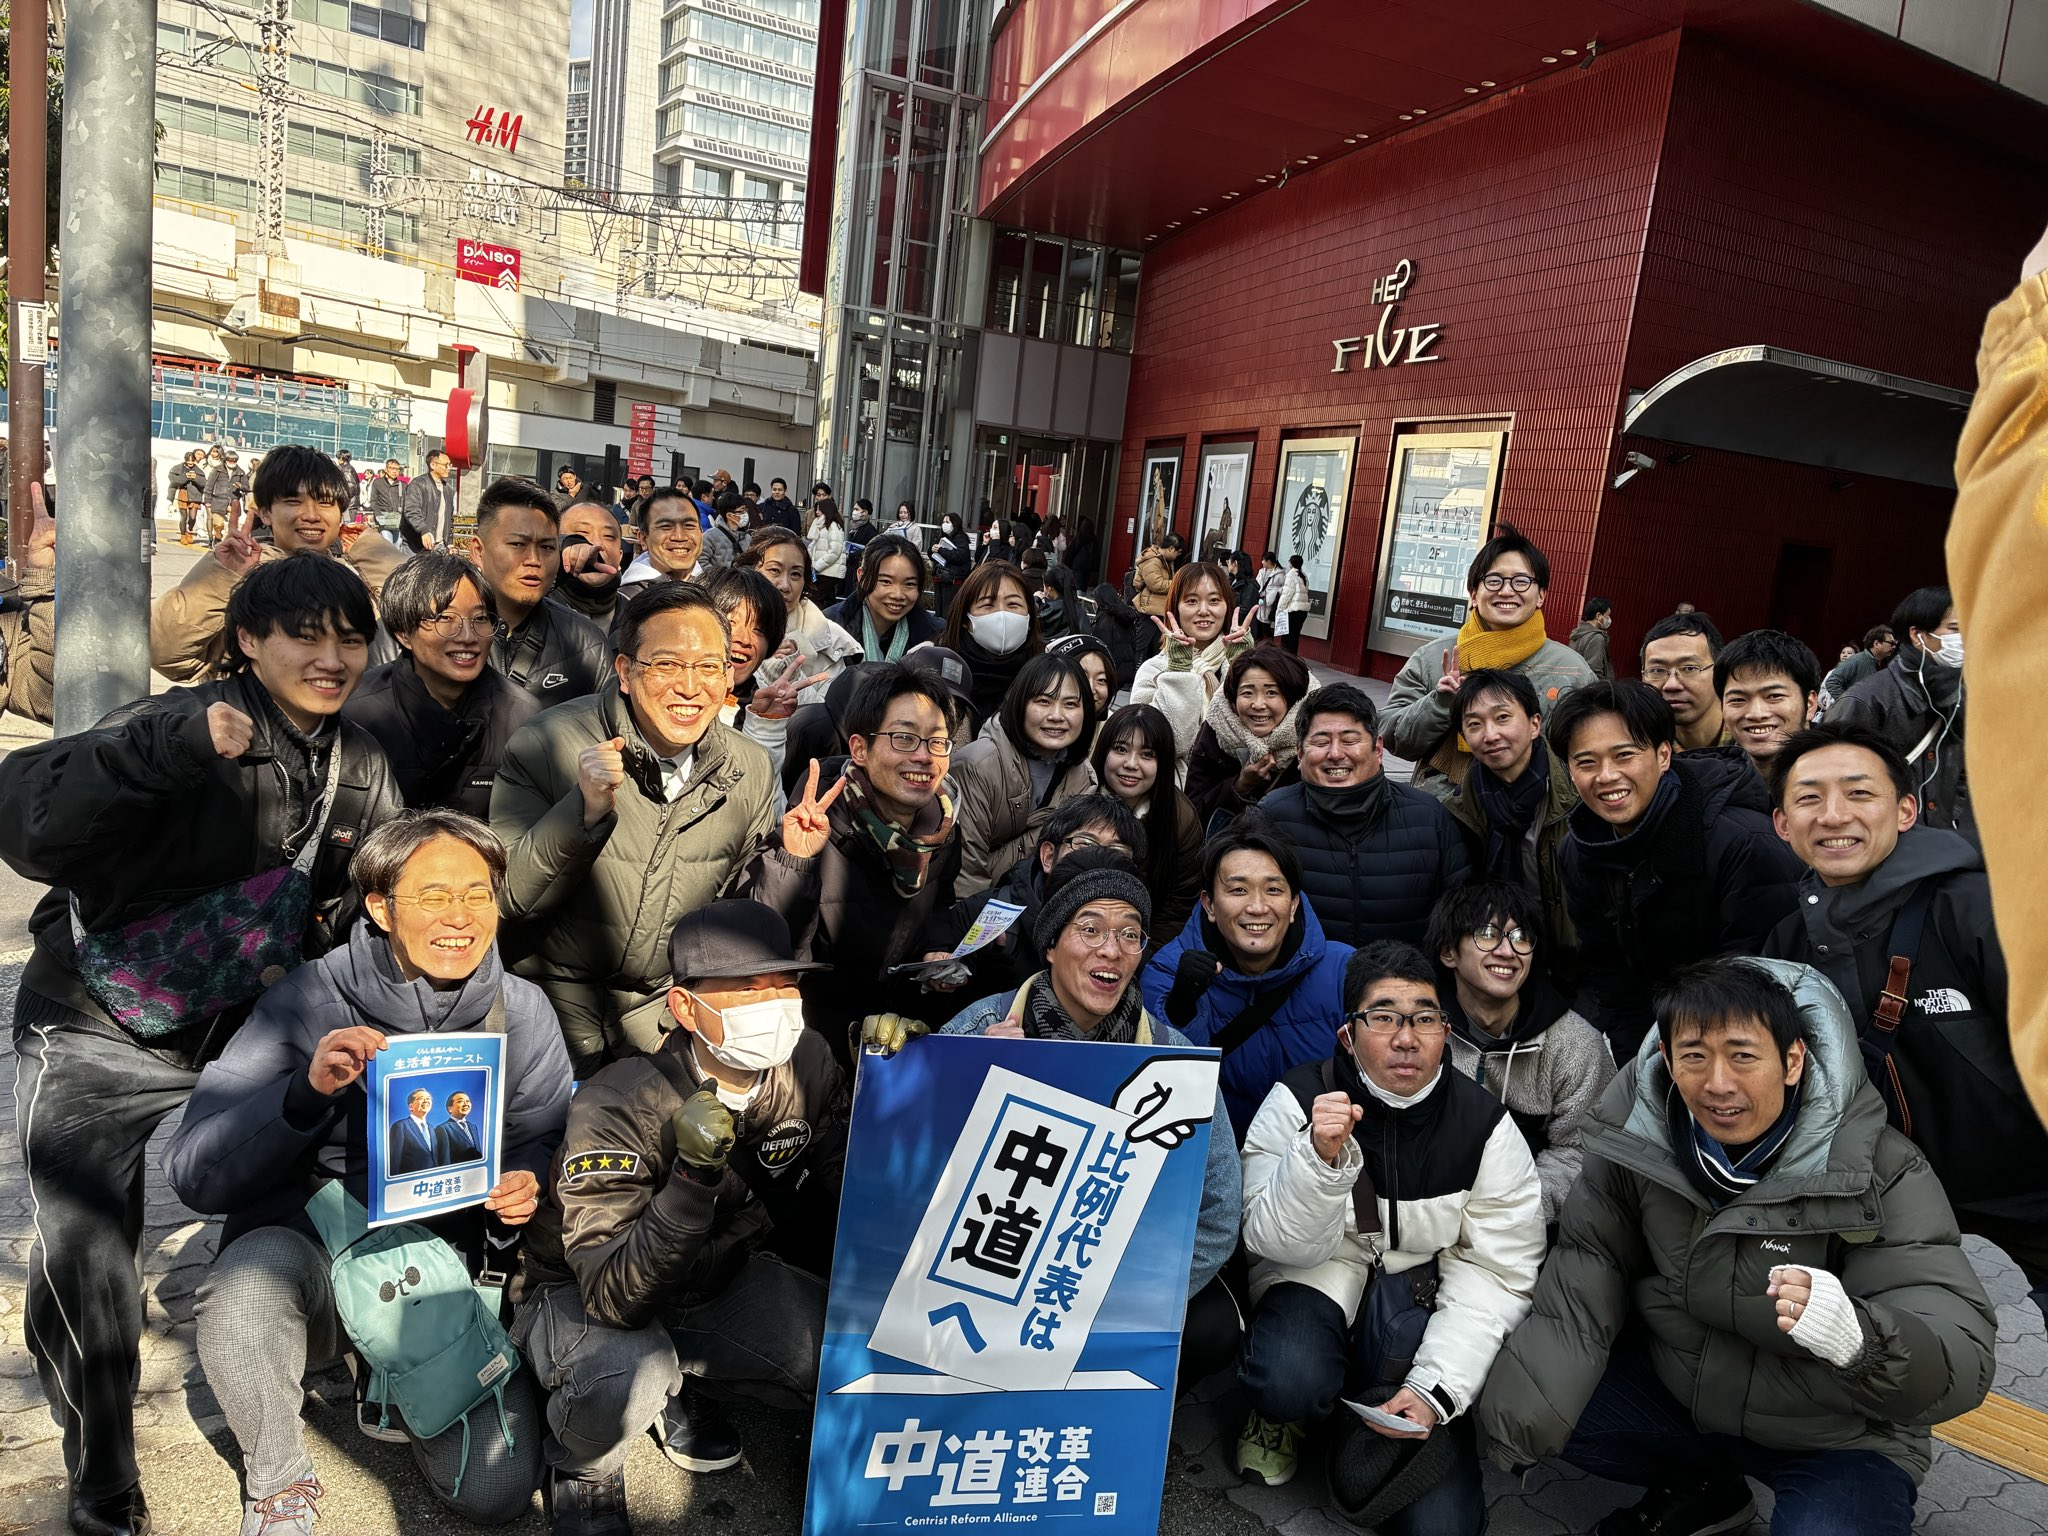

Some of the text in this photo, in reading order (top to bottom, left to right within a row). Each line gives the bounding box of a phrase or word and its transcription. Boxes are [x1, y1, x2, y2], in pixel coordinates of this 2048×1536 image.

[466, 104, 523, 155] H&M
[463, 167, 521, 204] ABC
[463, 243, 515, 265] DAISO
[1371, 258, 1411, 305] HEP
[1331, 303, 1440, 373] FIVE
[1208, 463, 1231, 490] SLY
[1429, 546, 1442, 560] 2F
[1913, 996, 1951, 1007] NORTH
[1925, 988, 1947, 998] THE
[1924, 1004, 1952, 1015] FACE
[394, 1053, 484, 1070] 生活者ファースト
[761, 1133, 807, 1152] DEFINITE
[1019, 1130, 1137, 1352] 比例代表は
[904, 1512, 1038, 1527] Centrist Reform Alliance
